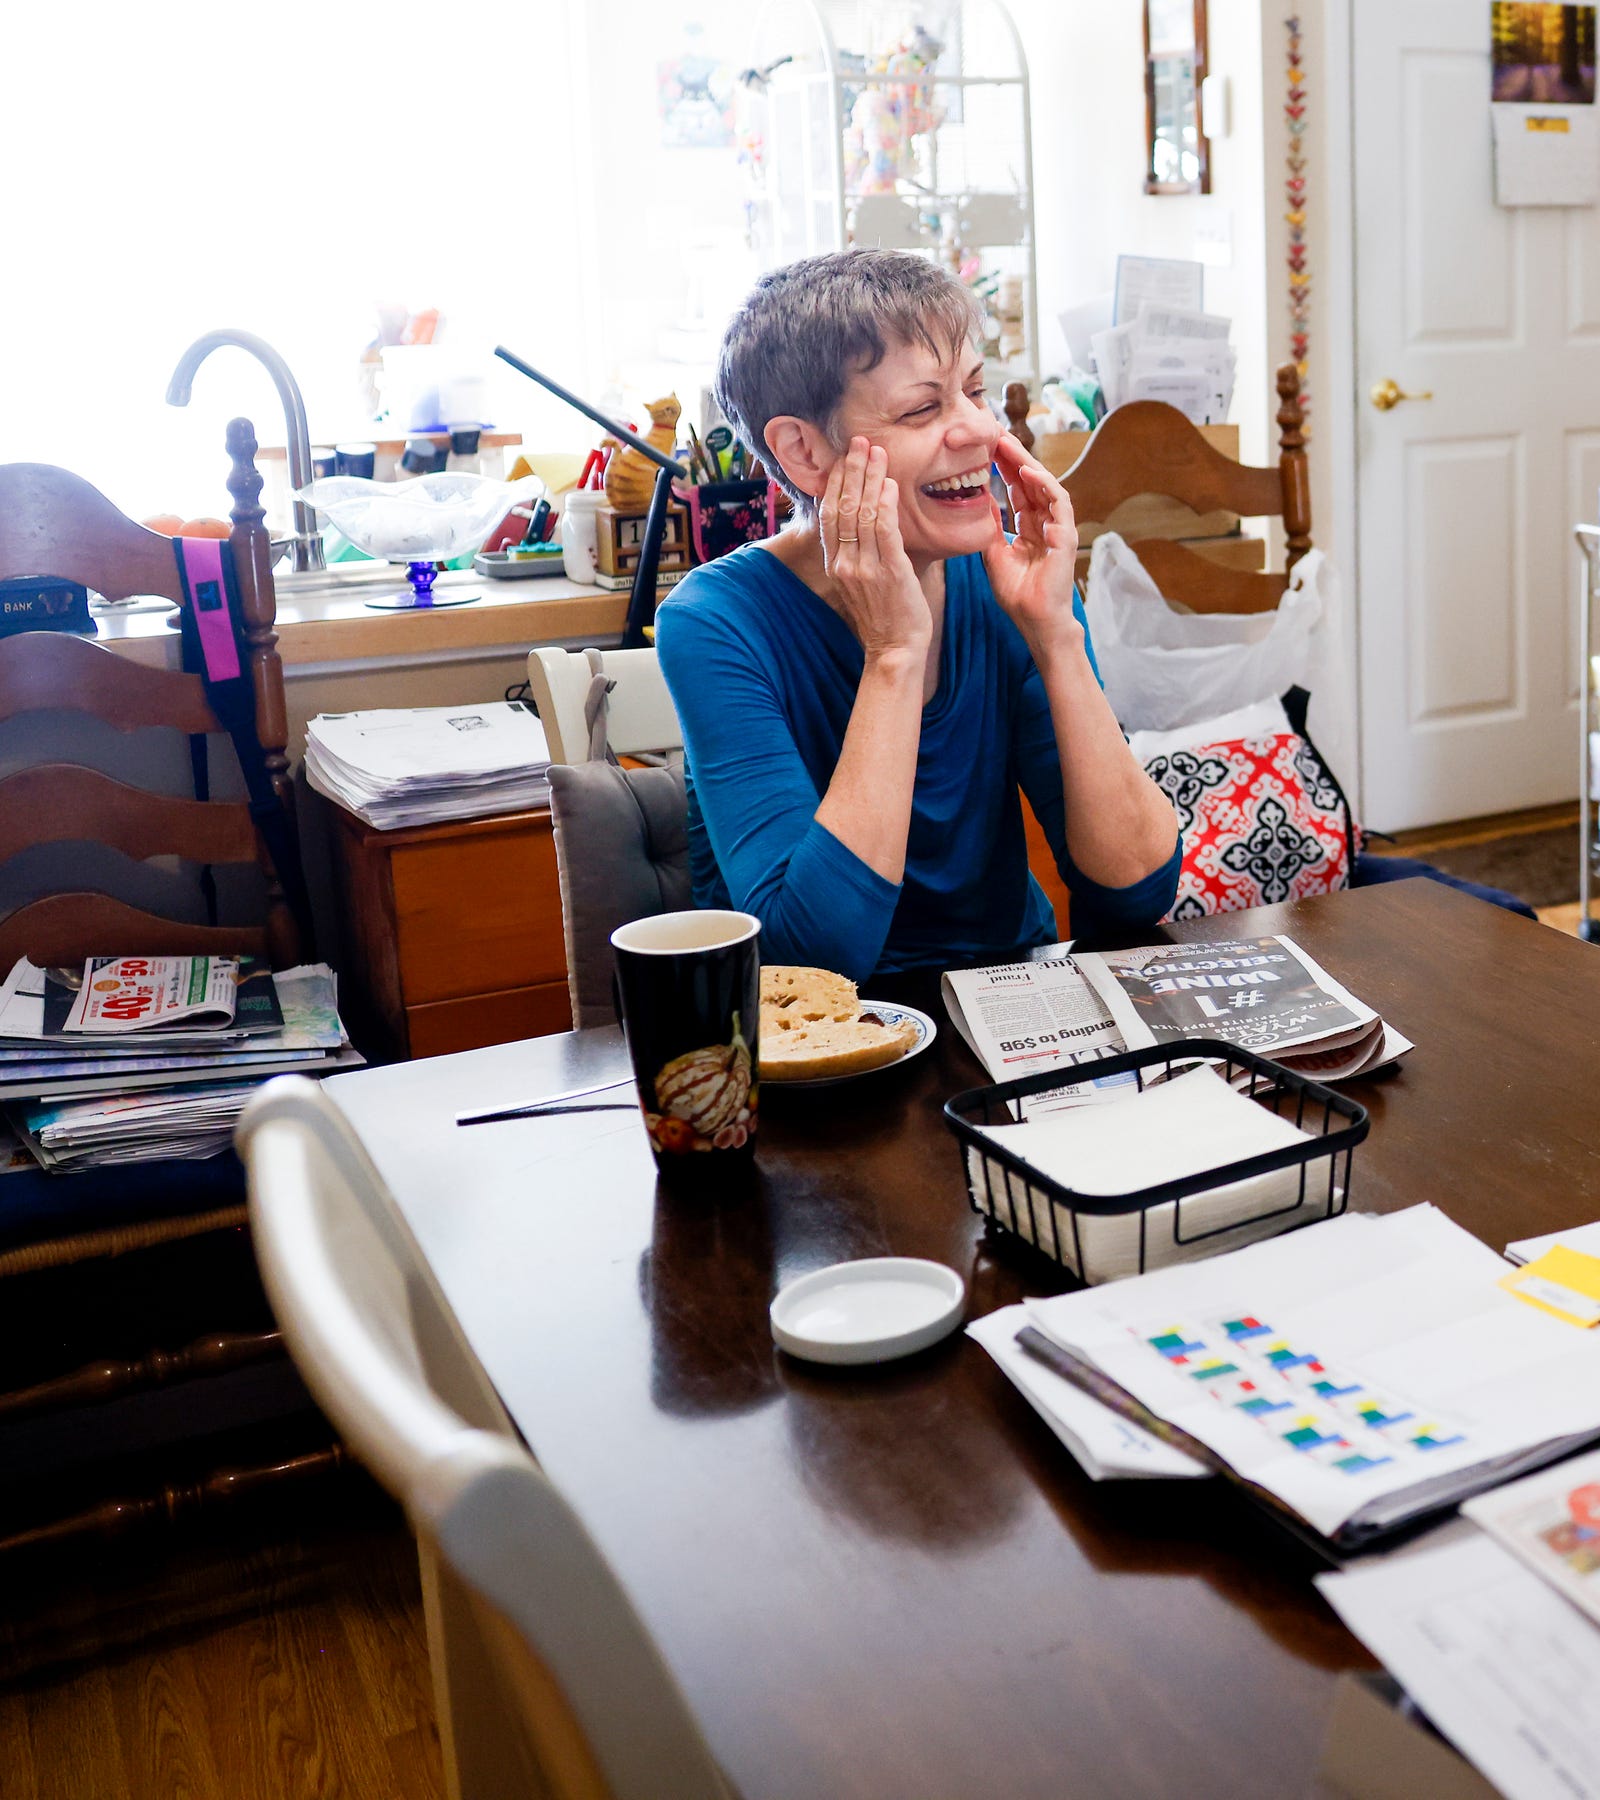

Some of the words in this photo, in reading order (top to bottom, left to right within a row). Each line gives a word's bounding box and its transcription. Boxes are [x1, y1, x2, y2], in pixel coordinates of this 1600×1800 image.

[4, 602, 33, 613] BANK
[1119, 954, 1288, 978] SELECTION
[989, 973, 1032, 985] Fraud
[1149, 970, 1282, 994] WINE
[1194, 989, 1267, 1018] #1
[1038, 1032, 1058, 1043] to
[1057, 1019, 1117, 1040] ending
[999, 1037, 1037, 1053] $9B
